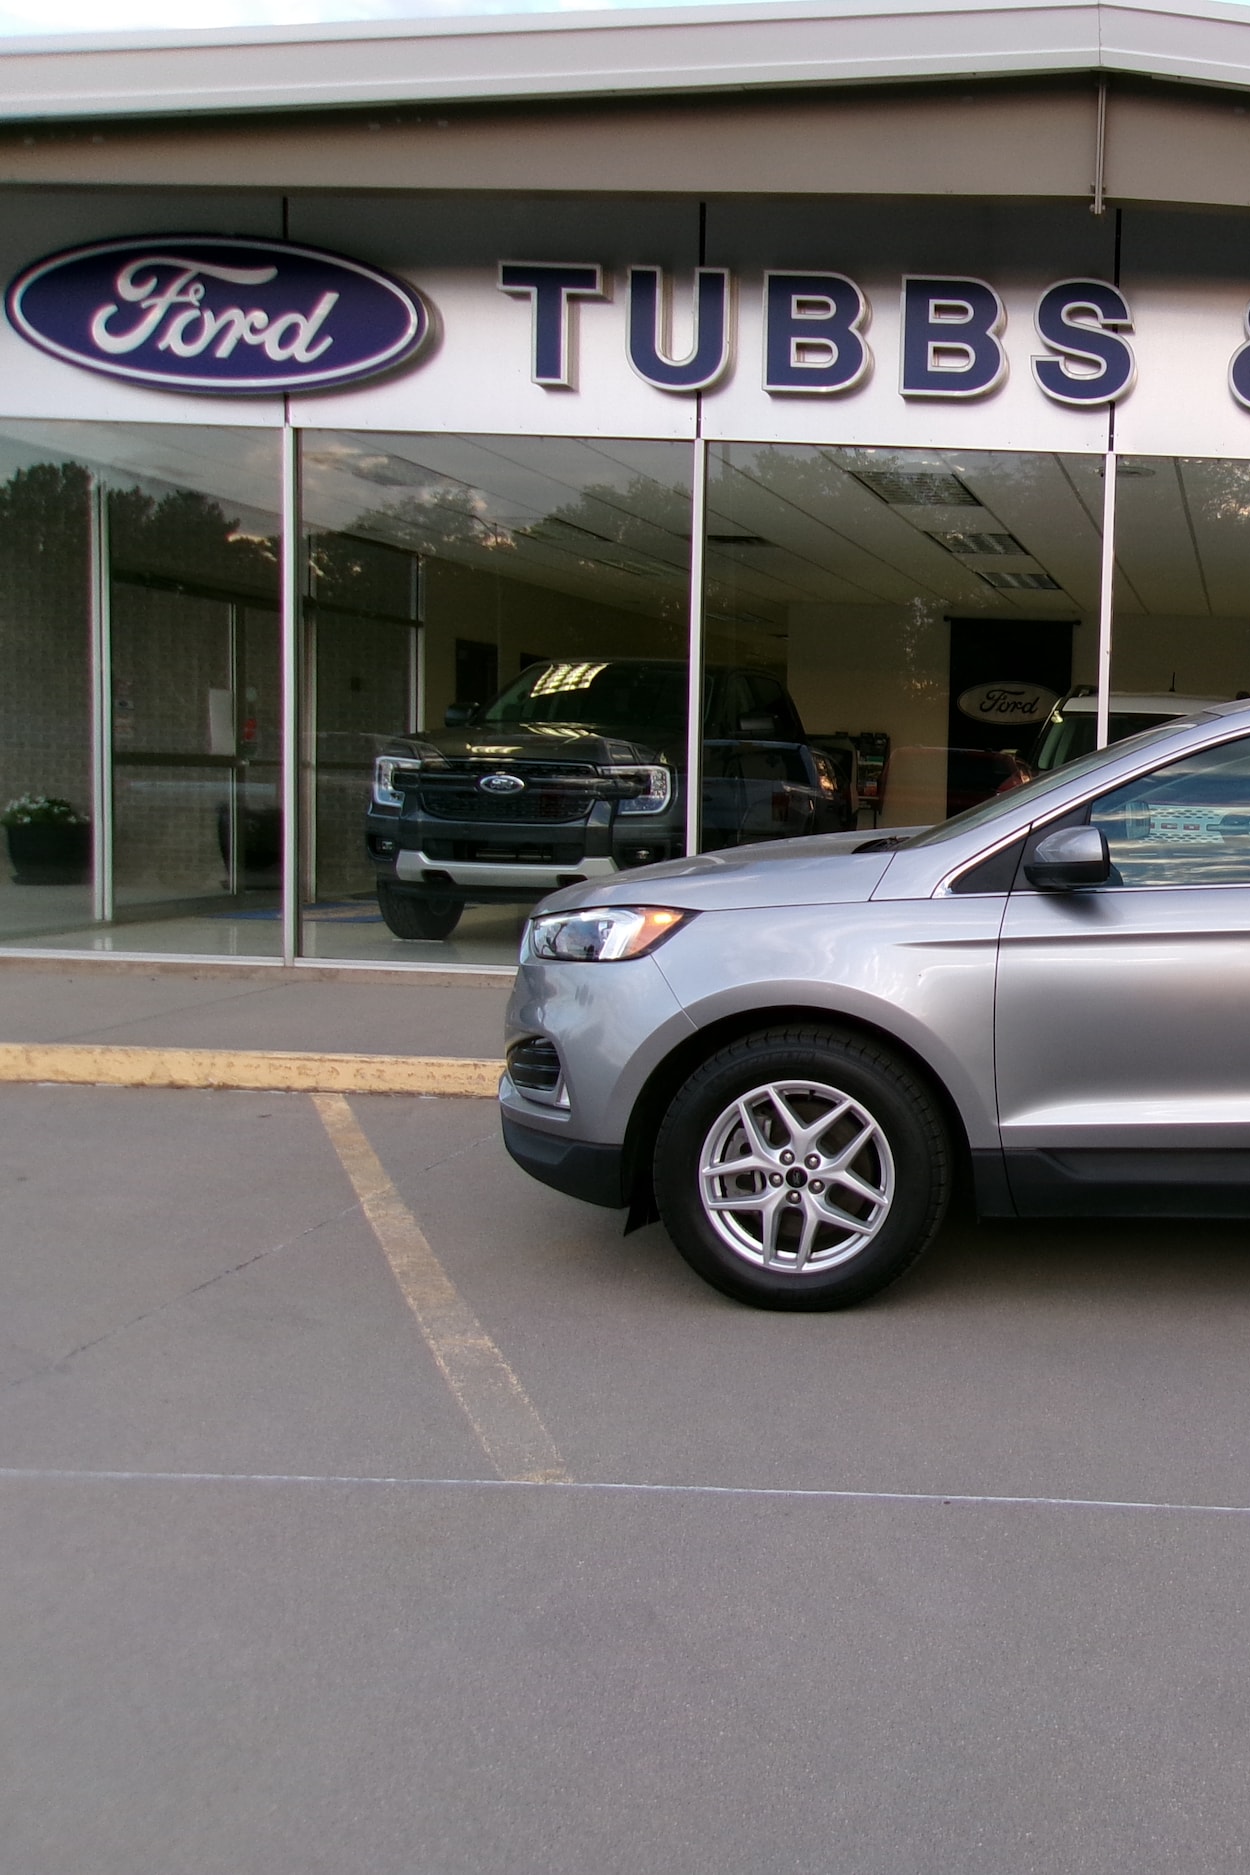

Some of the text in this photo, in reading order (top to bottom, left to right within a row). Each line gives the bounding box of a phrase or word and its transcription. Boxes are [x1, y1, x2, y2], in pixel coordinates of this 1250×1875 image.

[91, 256, 340, 363] Ford
[498, 261, 1138, 406] TUBBS
[979, 688, 1040, 714] Ford
